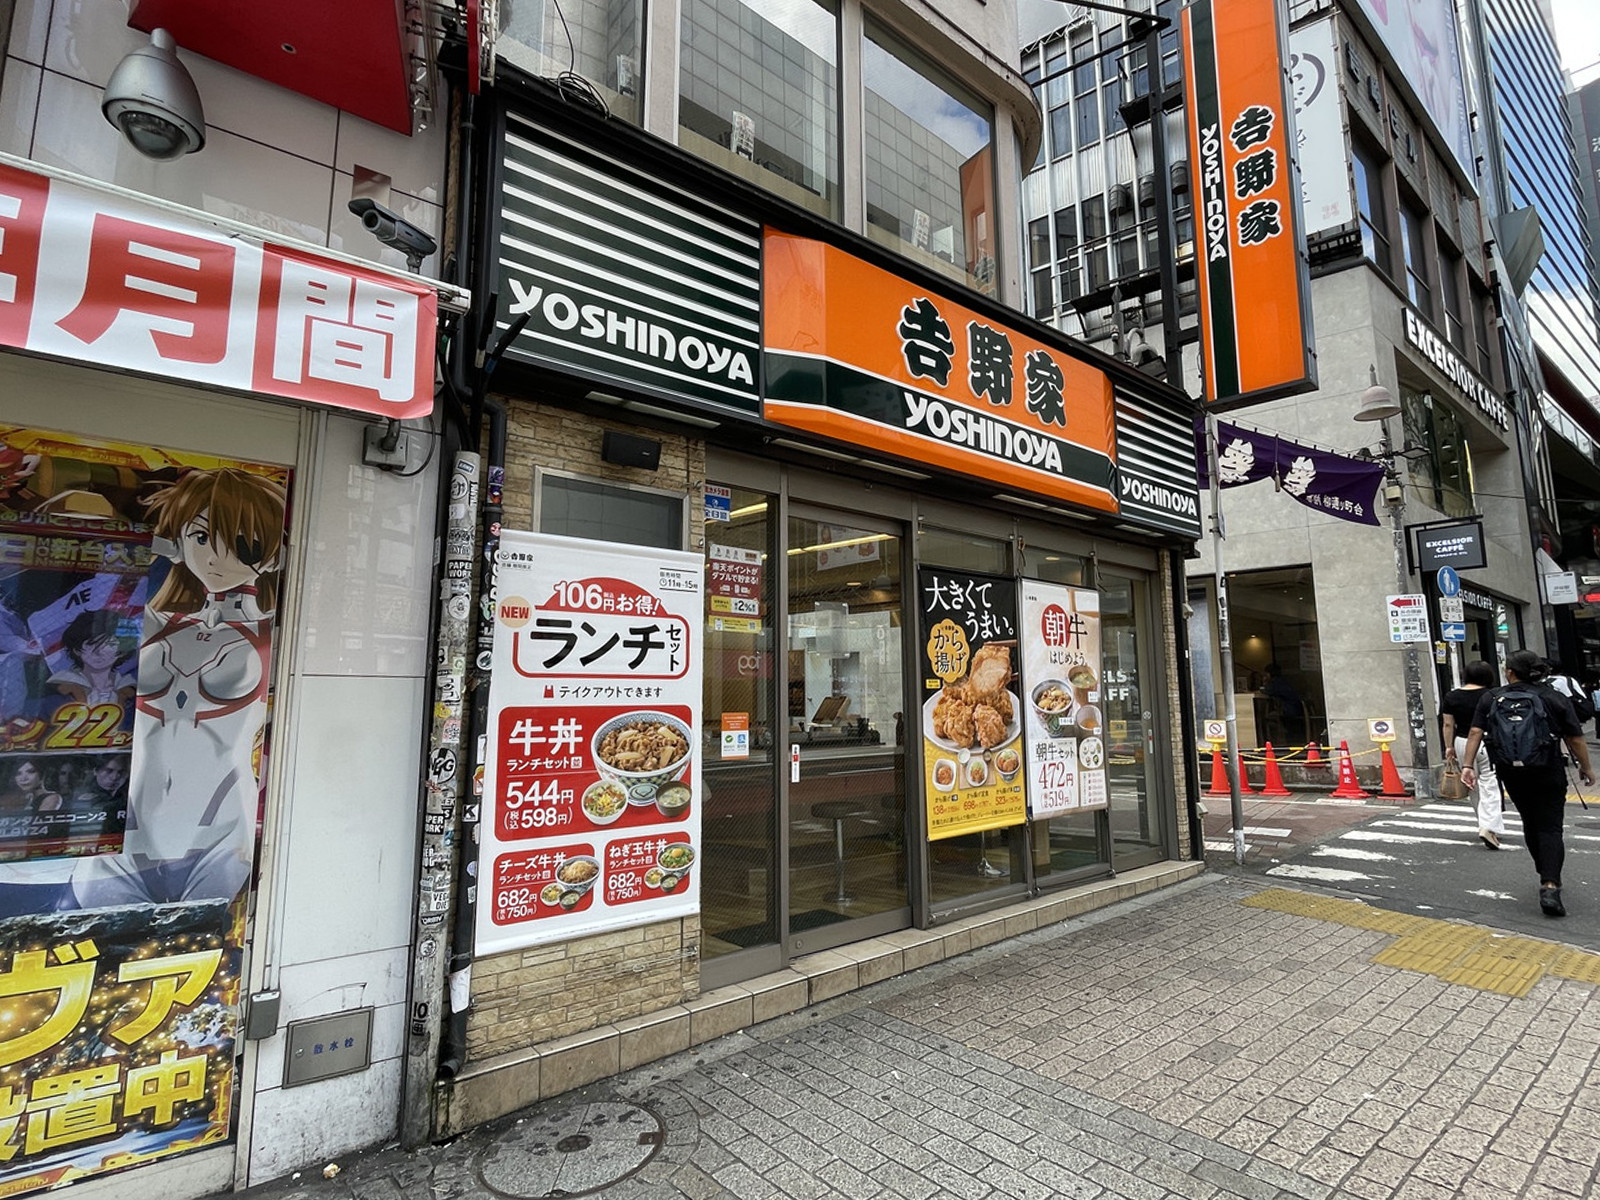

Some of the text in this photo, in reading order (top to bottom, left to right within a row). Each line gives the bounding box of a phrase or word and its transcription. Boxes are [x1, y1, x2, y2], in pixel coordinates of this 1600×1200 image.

[1229, 105, 1283, 248] 吉野家
[1201, 122, 1227, 262] YOSHINOYA
[507, 277, 755, 386] YOSHINOYA
[896, 297, 1067, 428] 吉野家
[1406, 308, 1477, 399] EXCELSIOR
[903, 391, 1064, 474] YOSHINOYA
[1121, 475, 1198, 517] YOSHINOYA
[1425, 536, 1474, 548] EXCELSIOR
[925, 576, 993, 613] 大きくて
[501, 605, 530, 619] NEW
[965, 611, 1014, 642] うまい。
[530, 618, 666, 671] ランチ
[934, 629, 963, 652] から
[1044, 609, 1089, 651] 朝牛
[665, 624, 683, 672] セット
[934, 651, 967, 674] 揚げ
[559, 685, 664, 700] テイクアウトできます
[508, 717, 584, 757] 牛丼
[1035, 741, 1075, 762] 朝牛セット
[506, 756, 569, 772] ランチセット
[1038, 761, 1074, 790] 472円
[505, 779, 575, 809] 544円
[499, 851, 567, 875] チーズ牛丼
[609, 838, 668, 859] ねぎ玉牛丼
[609, 856, 645, 870] ランチセット
[498, 871, 542, 886] ランチセット
[608, 872, 643, 891] 682円
[497, 888, 538, 908] 682円
